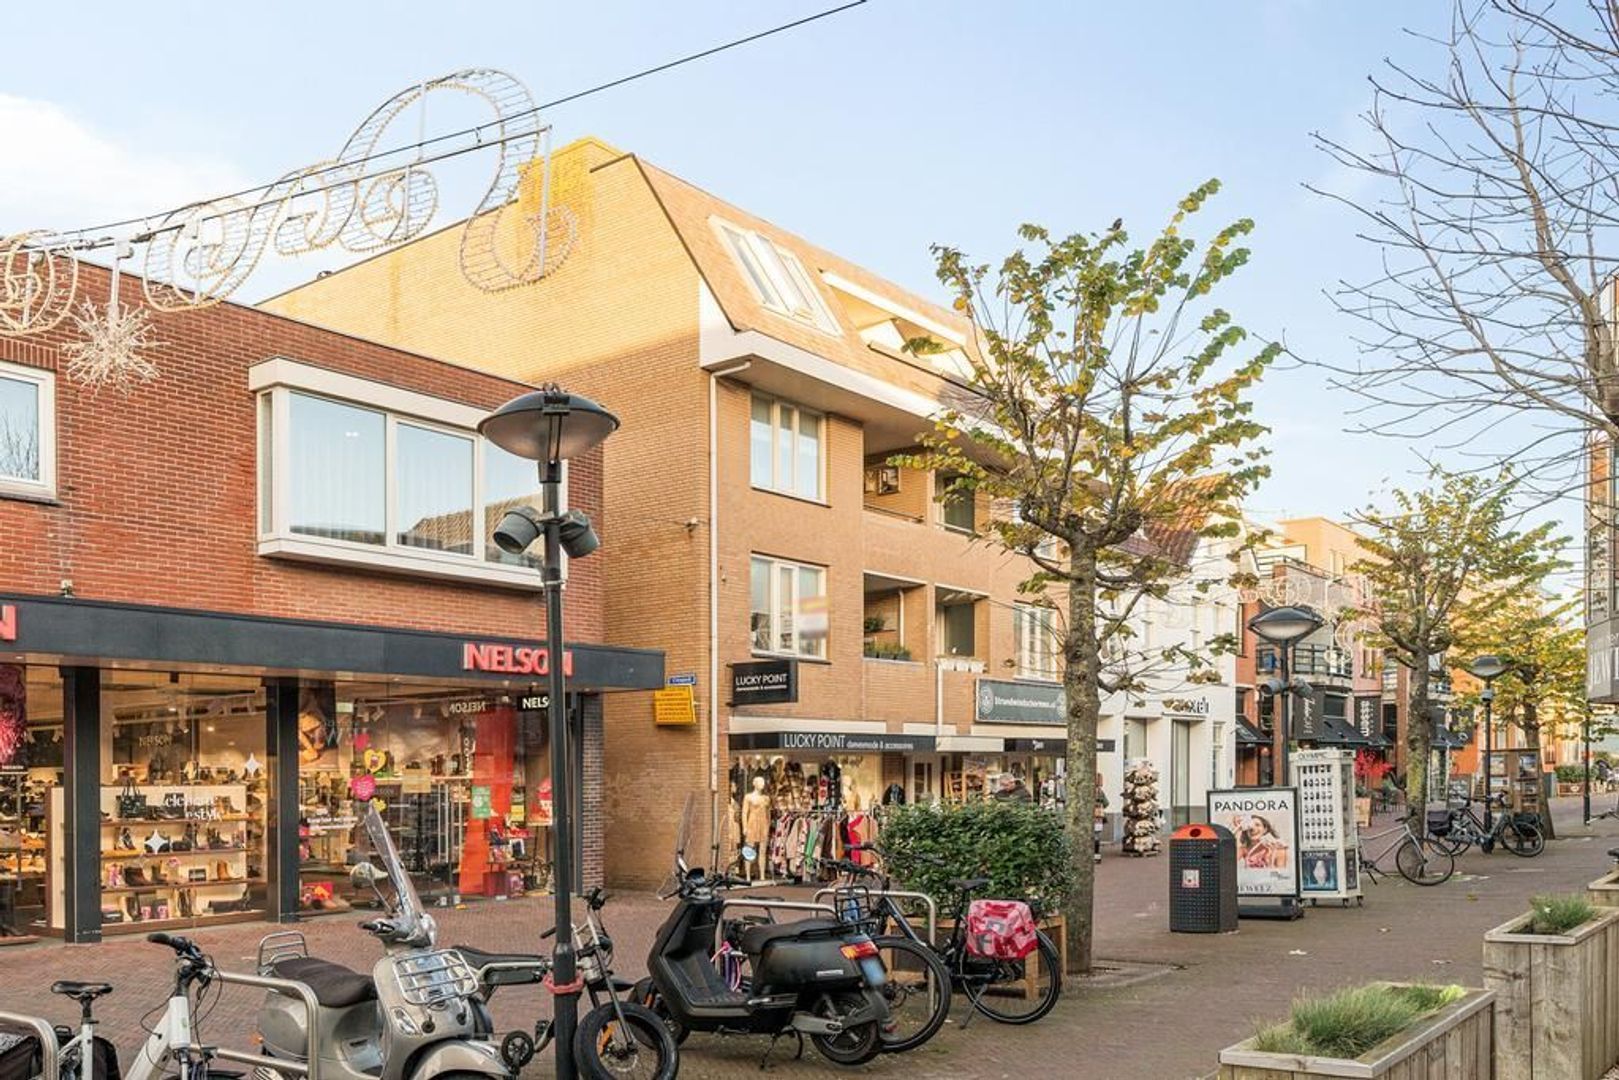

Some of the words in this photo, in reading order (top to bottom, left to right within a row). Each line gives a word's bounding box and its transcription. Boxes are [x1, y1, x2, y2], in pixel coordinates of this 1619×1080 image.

[735, 675, 762, 686] LUCKY
[762, 673, 788, 684] POINT
[522, 696, 549, 710] NELS
[784, 733, 815, 748] LUCKY
[817, 734, 846, 749] POINT
[1214, 799, 1289, 812] PANDORA
